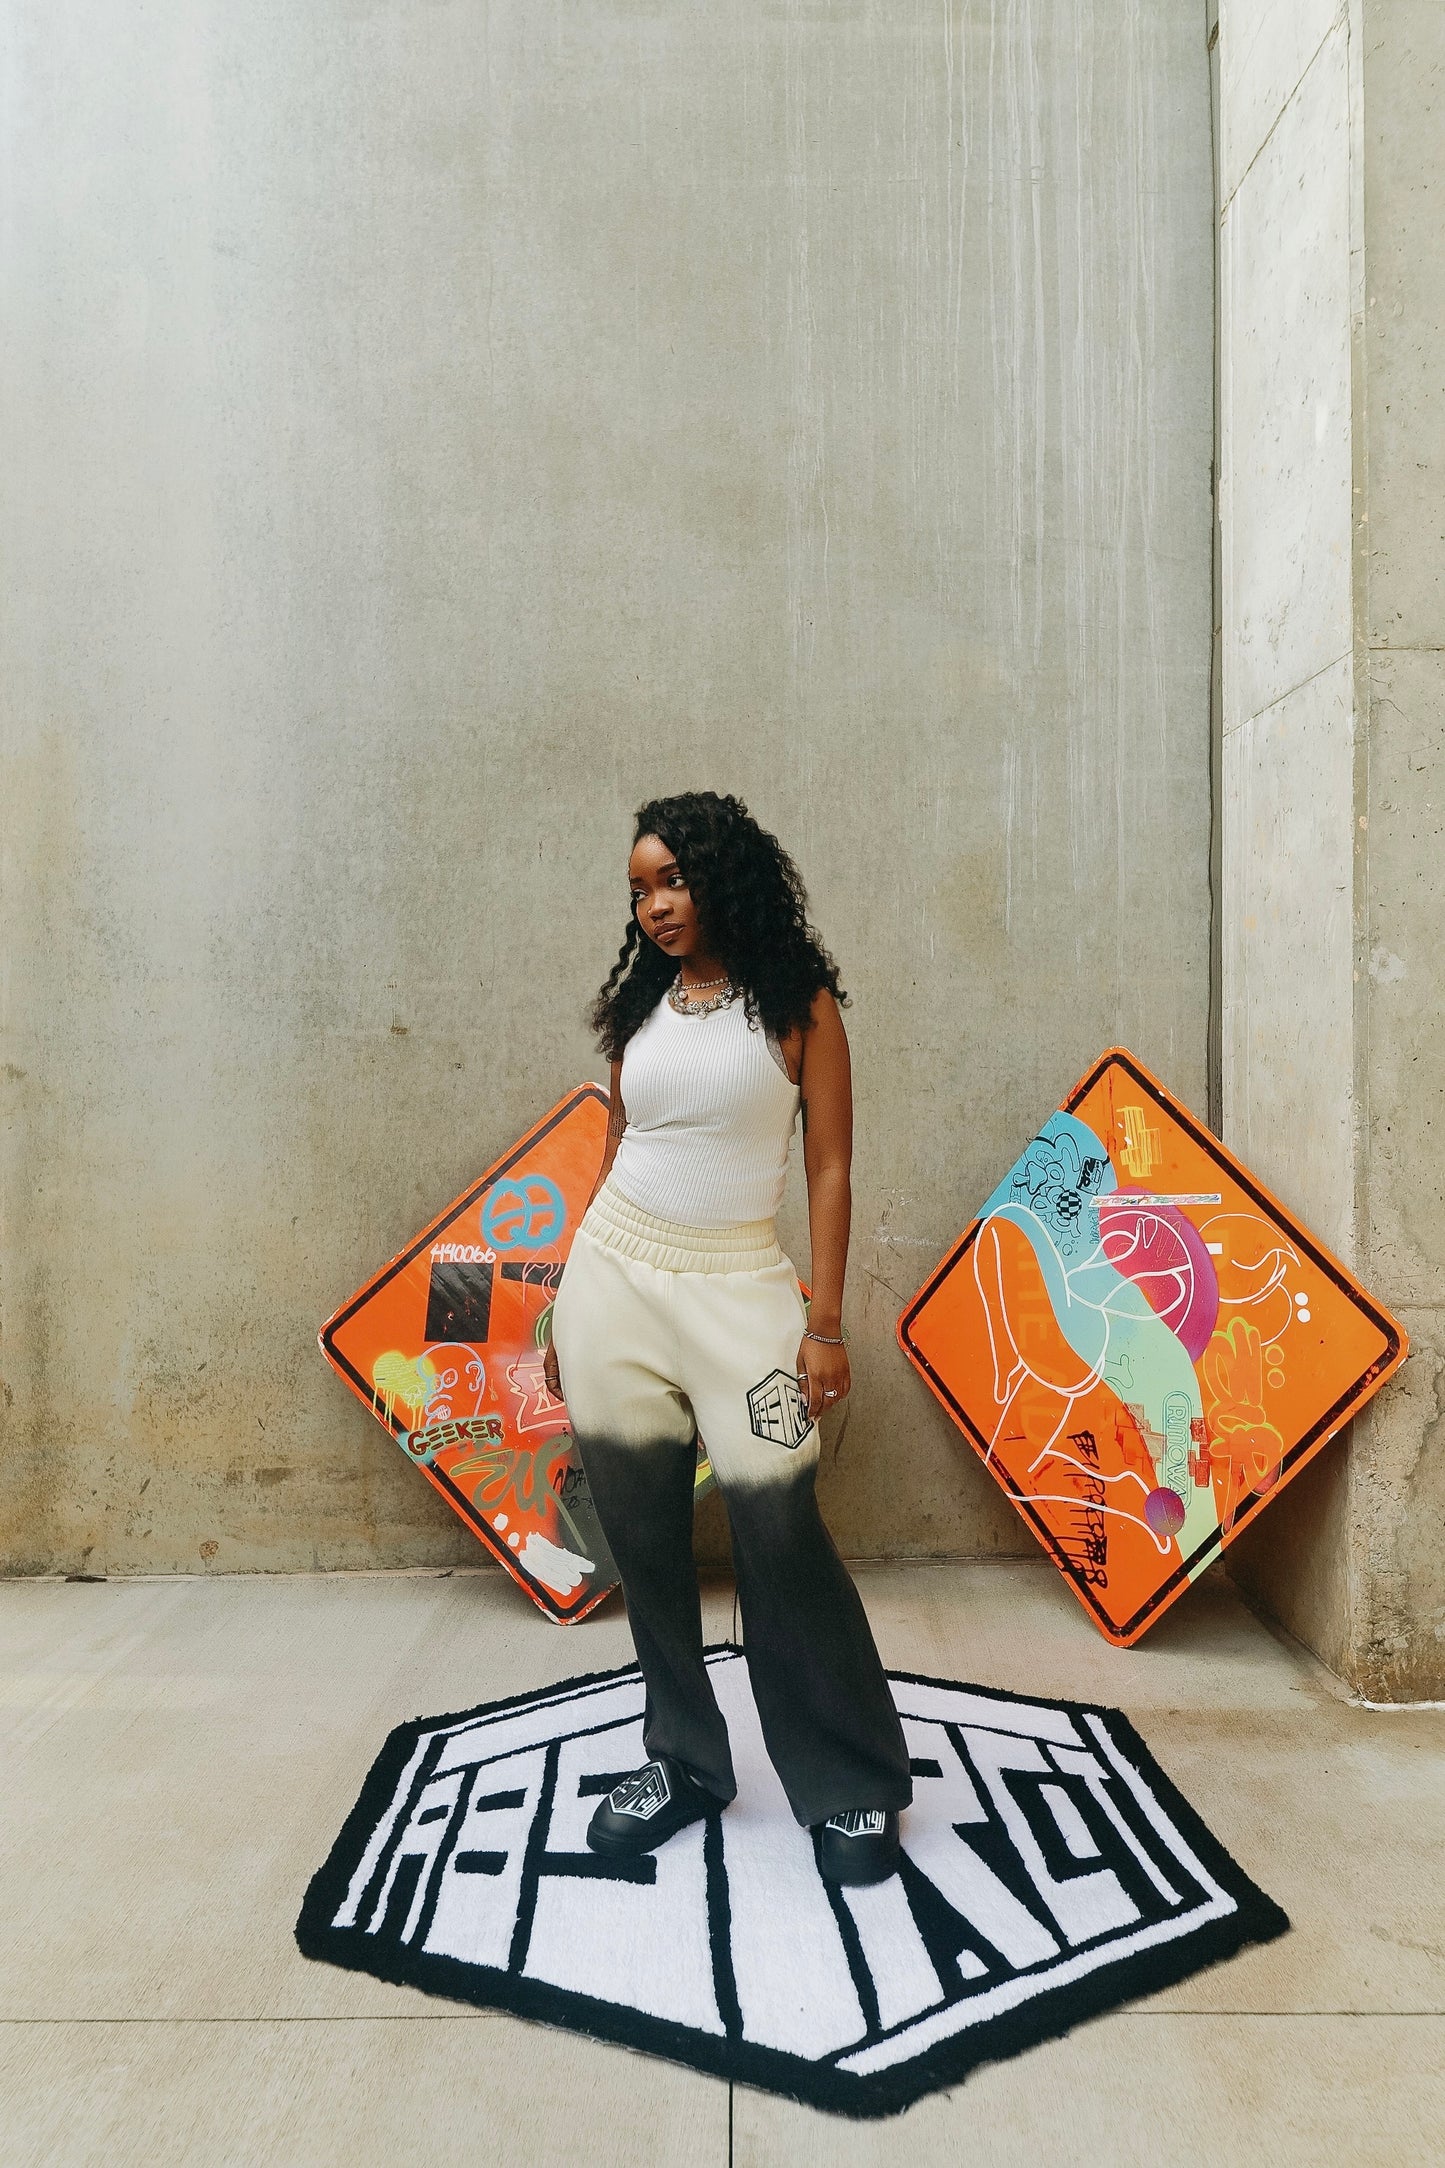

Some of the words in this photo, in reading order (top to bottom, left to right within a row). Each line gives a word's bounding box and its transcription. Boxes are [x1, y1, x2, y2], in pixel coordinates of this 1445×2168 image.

[430, 1243, 497, 1264] 440066
[407, 1418, 505, 1456] GEEKER
[1167, 1405, 1187, 1497] RIMOWA
